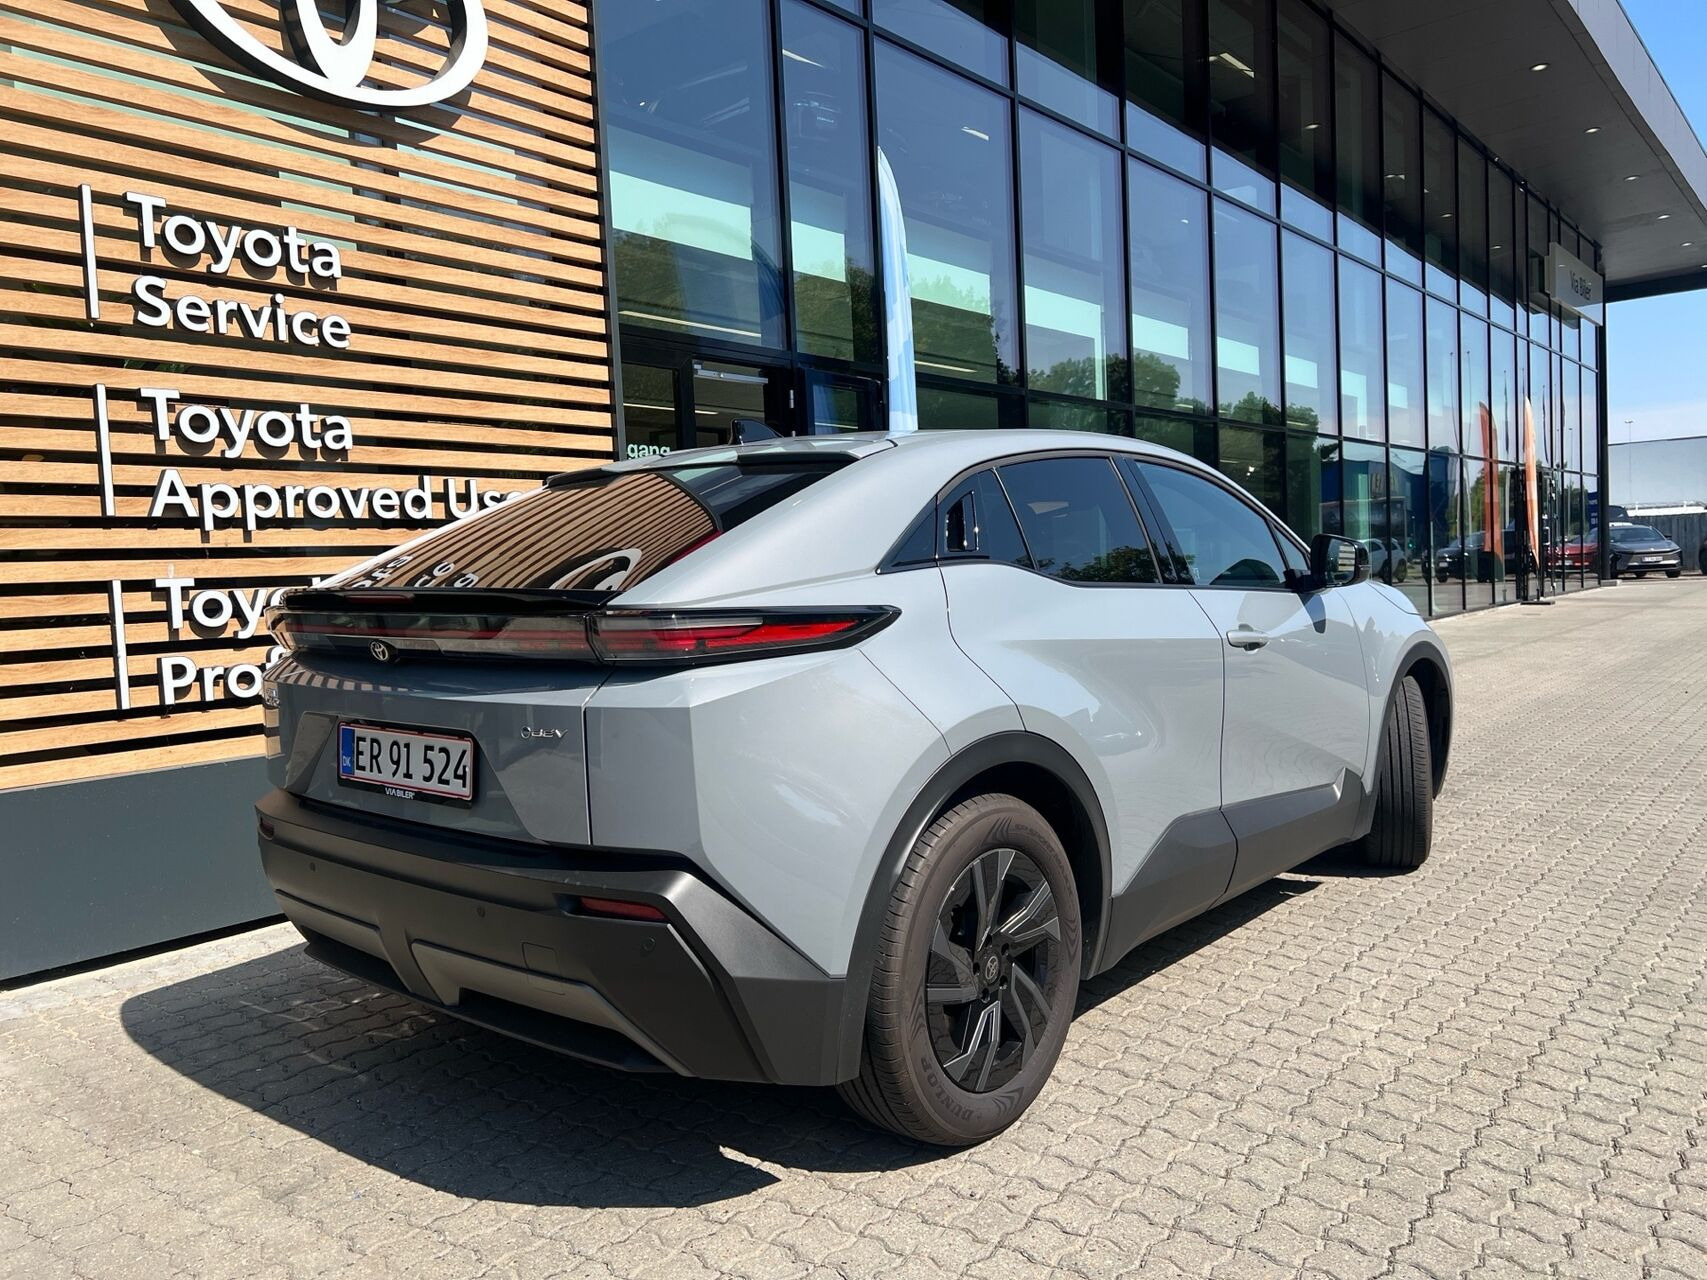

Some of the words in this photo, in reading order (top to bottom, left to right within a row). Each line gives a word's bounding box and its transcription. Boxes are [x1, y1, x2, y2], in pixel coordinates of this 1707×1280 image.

[125, 191, 342, 280] Toyota
[134, 275, 352, 349] Service
[140, 387, 353, 459] Toyota
[150, 468, 433, 532] Approved
[447, 477, 522, 520] Us
[342, 755, 352, 768] DK
[355, 736, 383, 775] ER
[389, 740, 413, 780] 91
[422, 744, 468, 789] 524
[921, 1057, 974, 1119] DUNLOP
